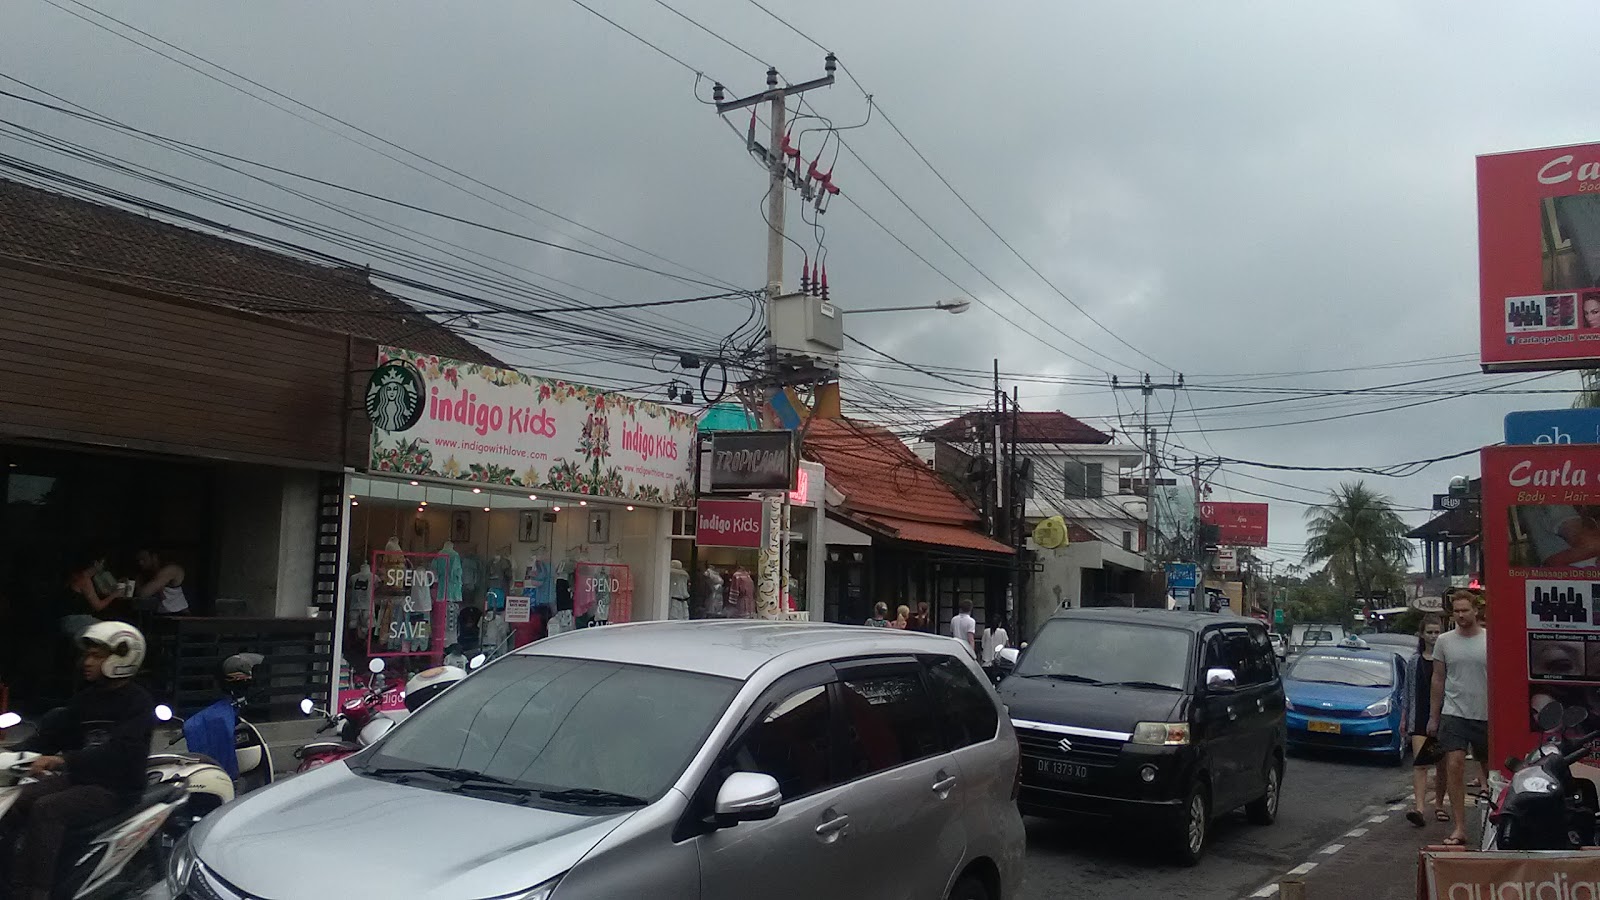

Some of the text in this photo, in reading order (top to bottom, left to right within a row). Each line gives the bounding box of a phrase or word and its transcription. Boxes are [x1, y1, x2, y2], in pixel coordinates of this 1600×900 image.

[430, 386, 557, 438] indigo Kids
[435, 438, 548, 461] www.indigowithlove.com
[622, 421, 677, 461] indigo Kids
[1509, 460, 1586, 487] Carla
[1517, 491, 1589, 504] Body Hair
[700, 514, 760, 534] indigo Kids
[386, 568, 435, 587] SPEND
[1509, 569, 1529, 578] Body
[1531, 569, 1568, 579] Massage
[585, 578, 620, 593] SPEND
[403, 595, 415, 613] &
[389, 621, 426, 639] SAVE
[1038, 760, 1049, 771] DK
[1053, 762, 1072, 776] 1373
